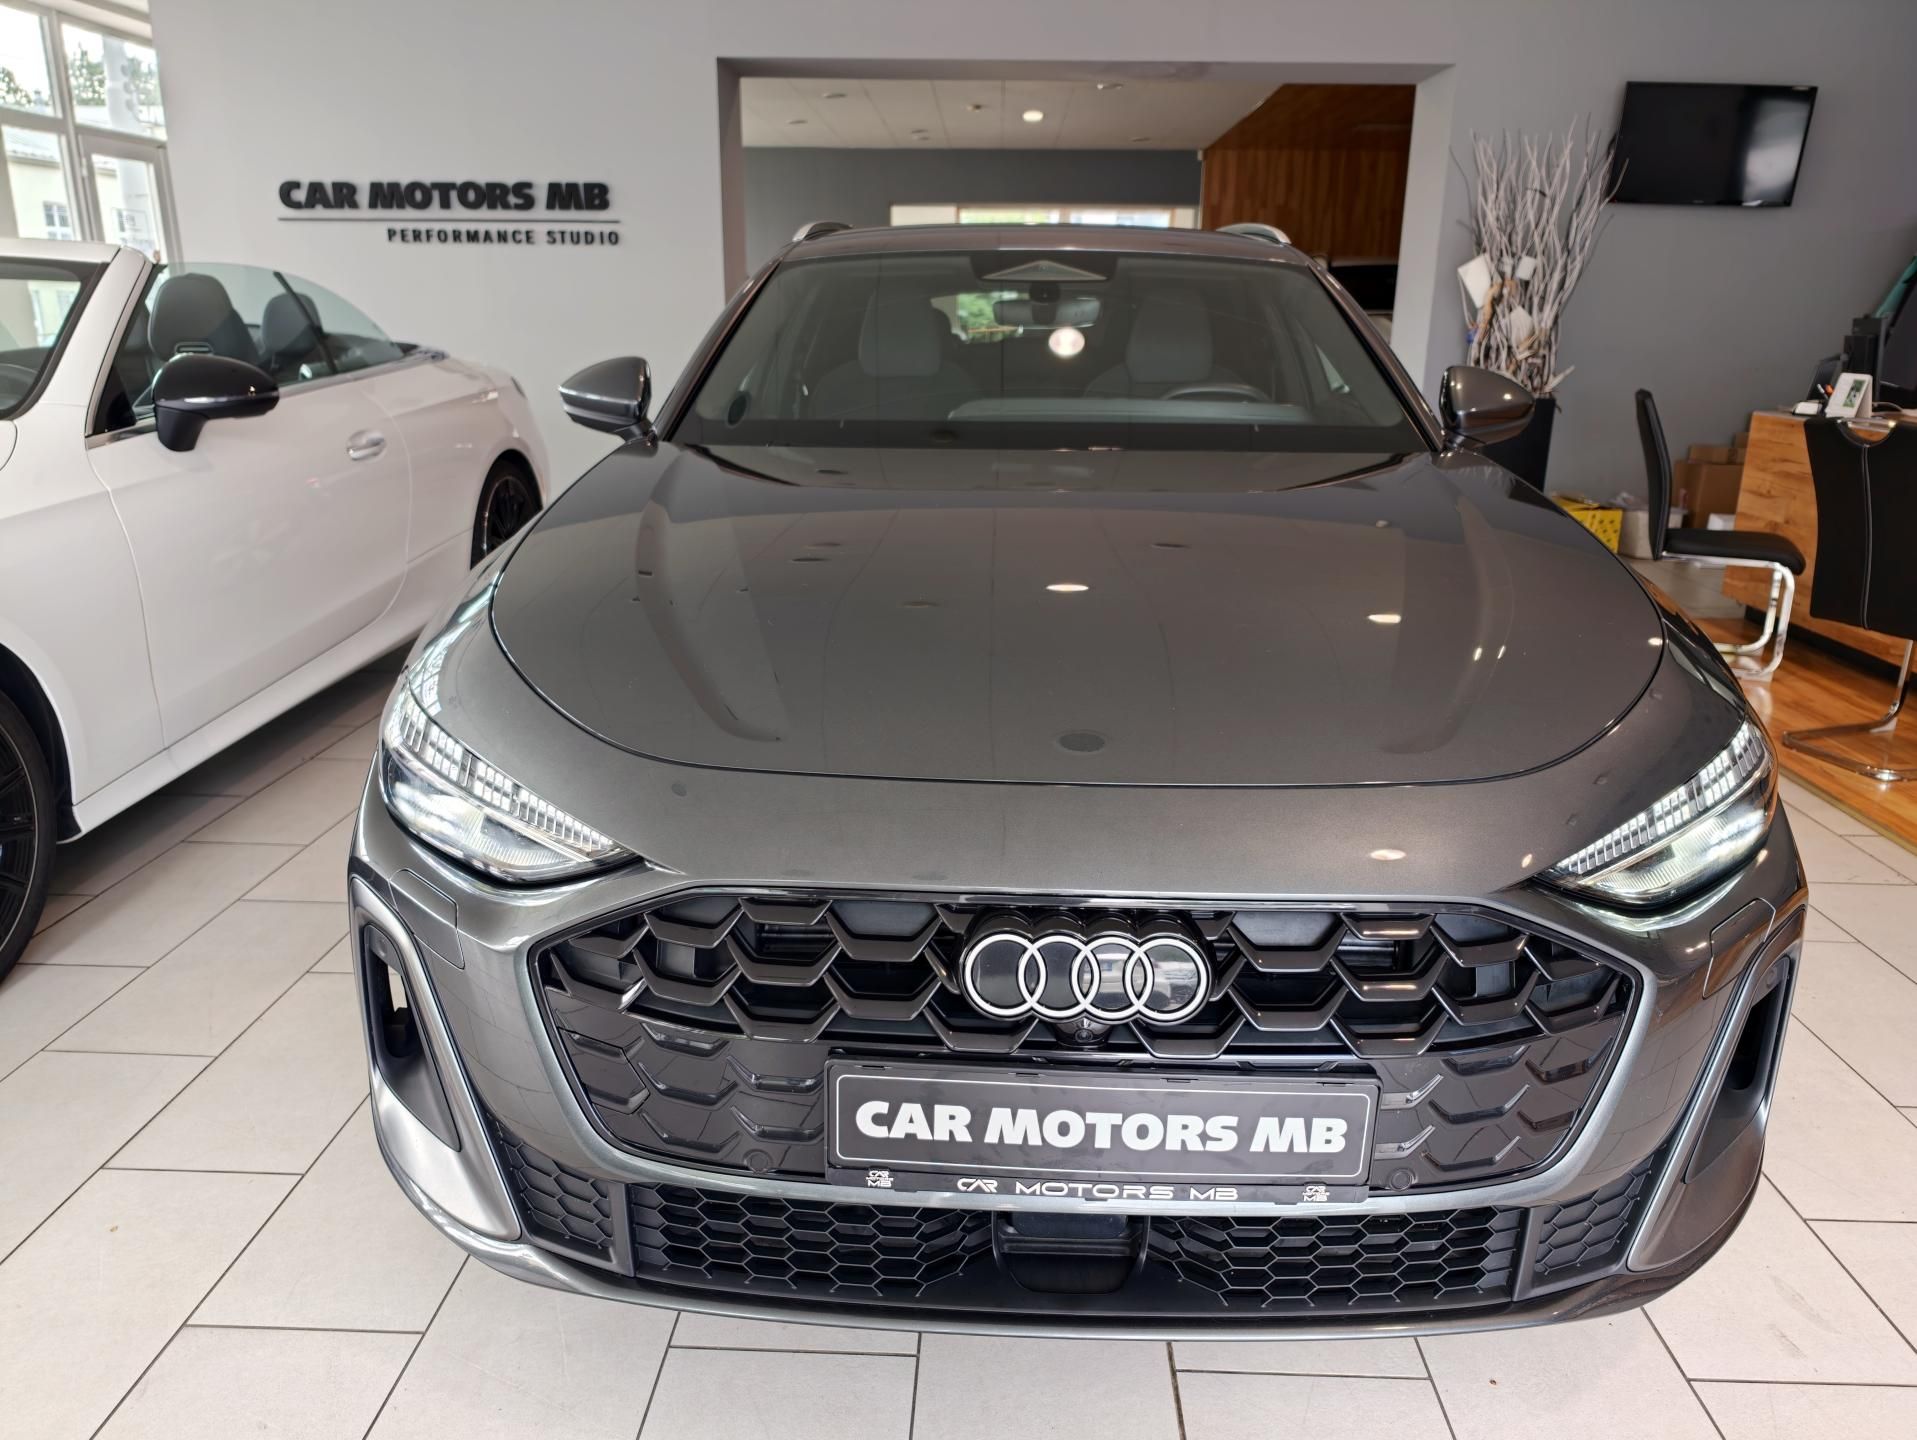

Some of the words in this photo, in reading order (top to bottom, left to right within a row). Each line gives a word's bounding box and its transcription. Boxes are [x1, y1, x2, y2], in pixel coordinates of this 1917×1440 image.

[279, 181, 360, 210] CAR
[368, 181, 535, 210] MOTORS
[545, 182, 610, 211] MB
[387, 228, 535, 244] PERFORMANCE
[546, 230, 620, 245] STUDIO
[856, 1100, 972, 1143] CAR
[983, 1107, 1238, 1152] MOTORS
[1249, 1116, 1348, 1153] MB
[957, 1178, 998, 1193] CAR
[1015, 1181, 1174, 1199] MOTORS
[1190, 1187, 1238, 1200] MB
